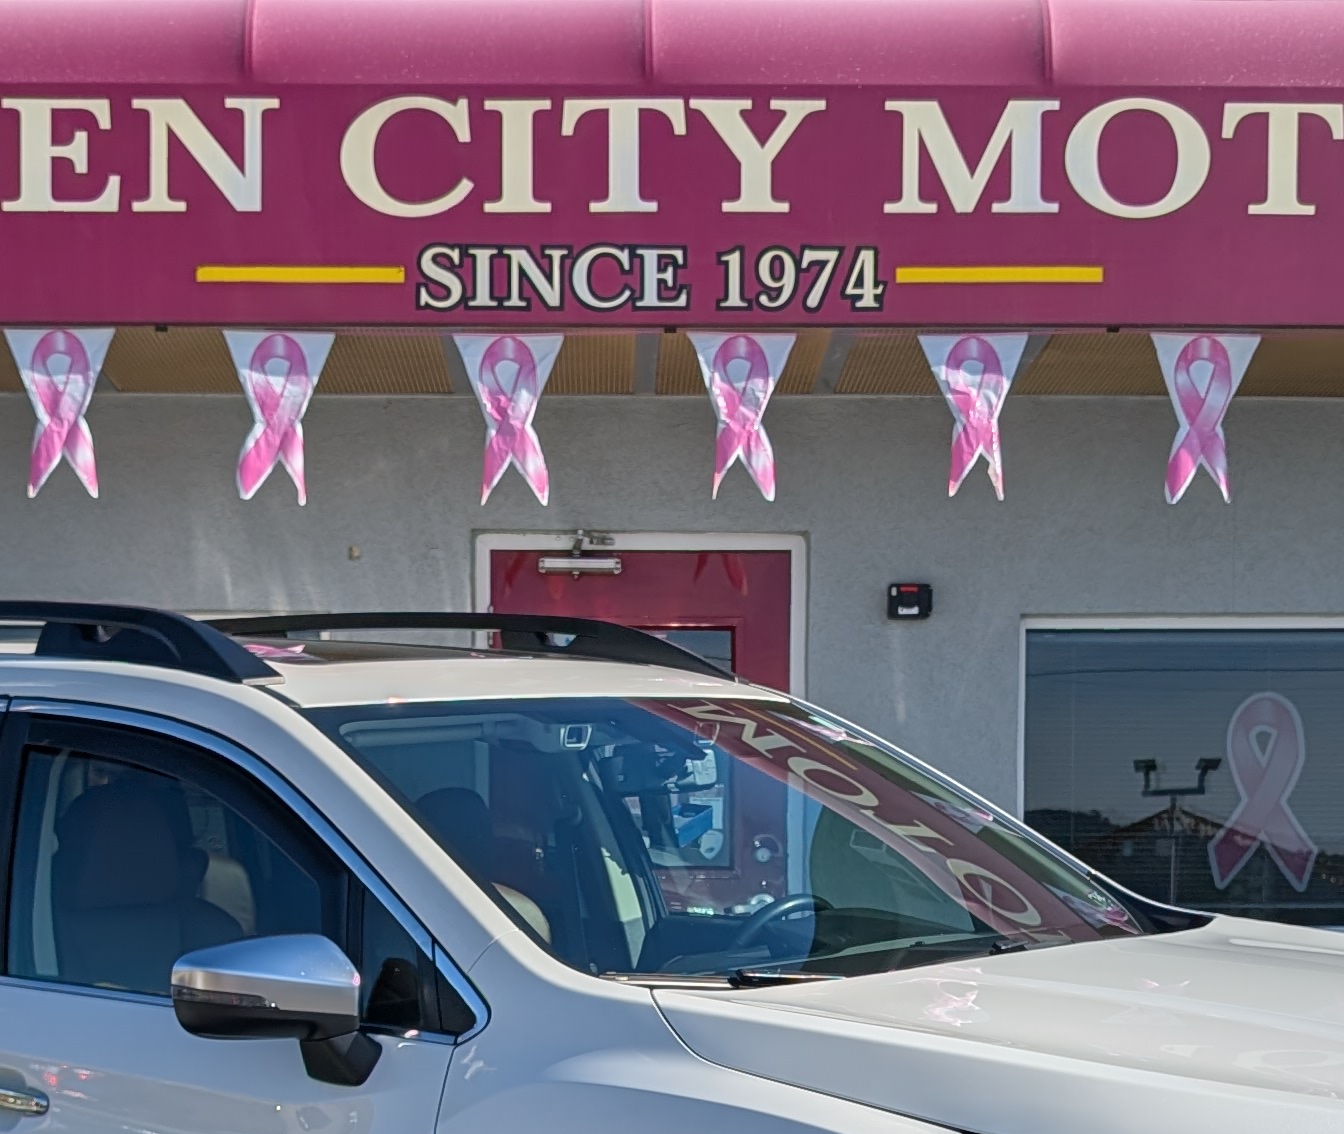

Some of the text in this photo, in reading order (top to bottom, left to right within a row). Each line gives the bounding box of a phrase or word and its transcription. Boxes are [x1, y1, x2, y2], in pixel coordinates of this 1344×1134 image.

[339, 96, 826, 218] CITY
[417, 243, 887, 313] SINCE 1974
